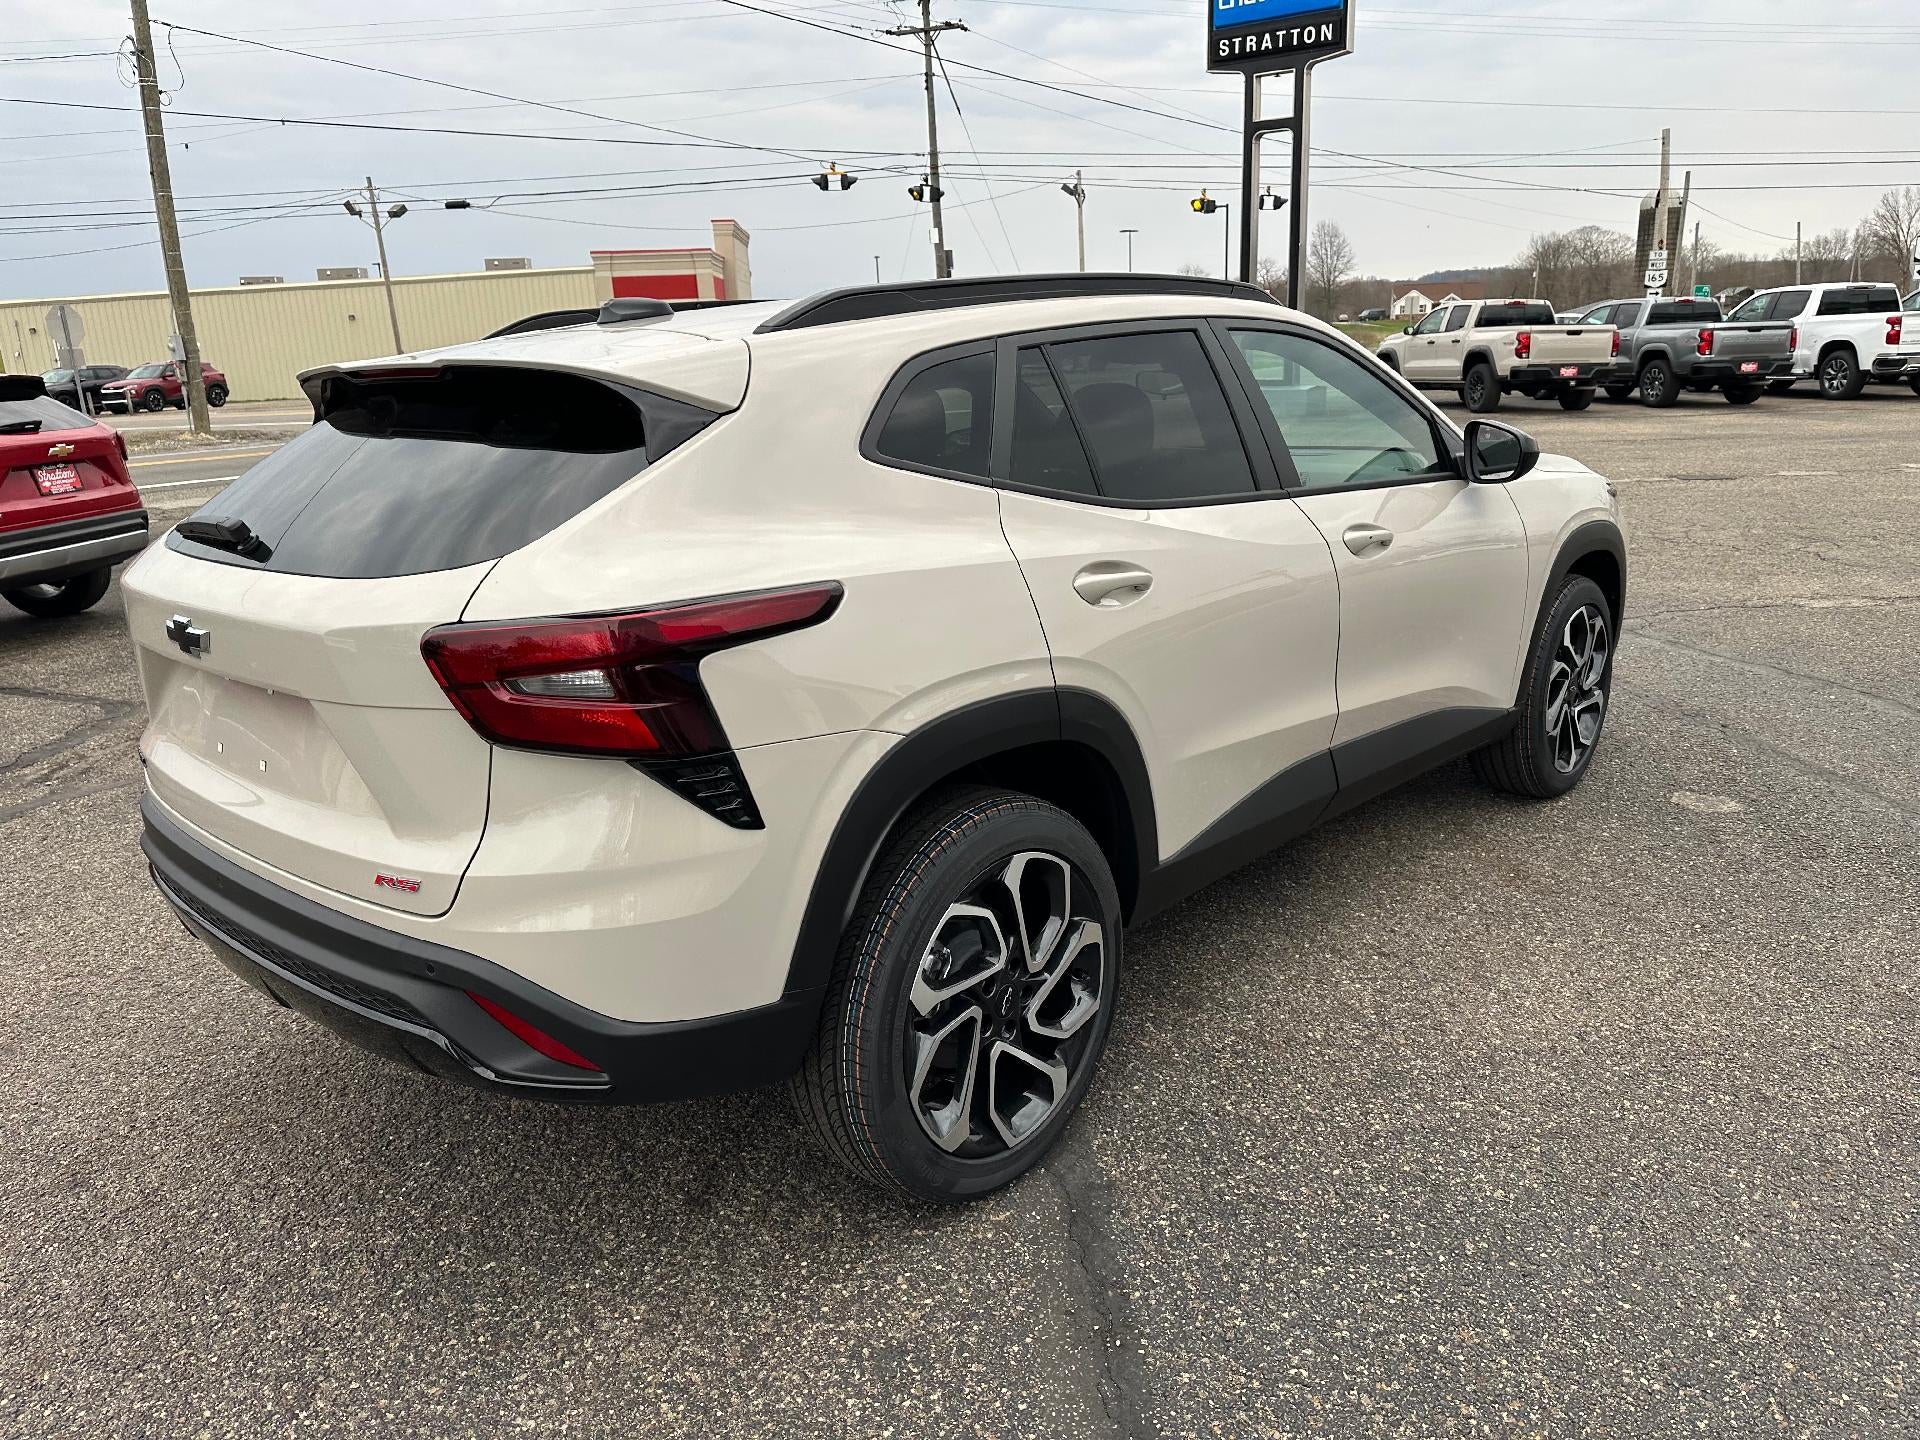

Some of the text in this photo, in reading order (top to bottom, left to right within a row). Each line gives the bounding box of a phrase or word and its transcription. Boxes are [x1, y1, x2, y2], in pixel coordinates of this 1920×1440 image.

[1219, 23, 1333, 57] STRATTON
[1647, 273, 1664, 282] 165
[38, 469, 75, 482] Stratton
[374, 873, 421, 892] RS
